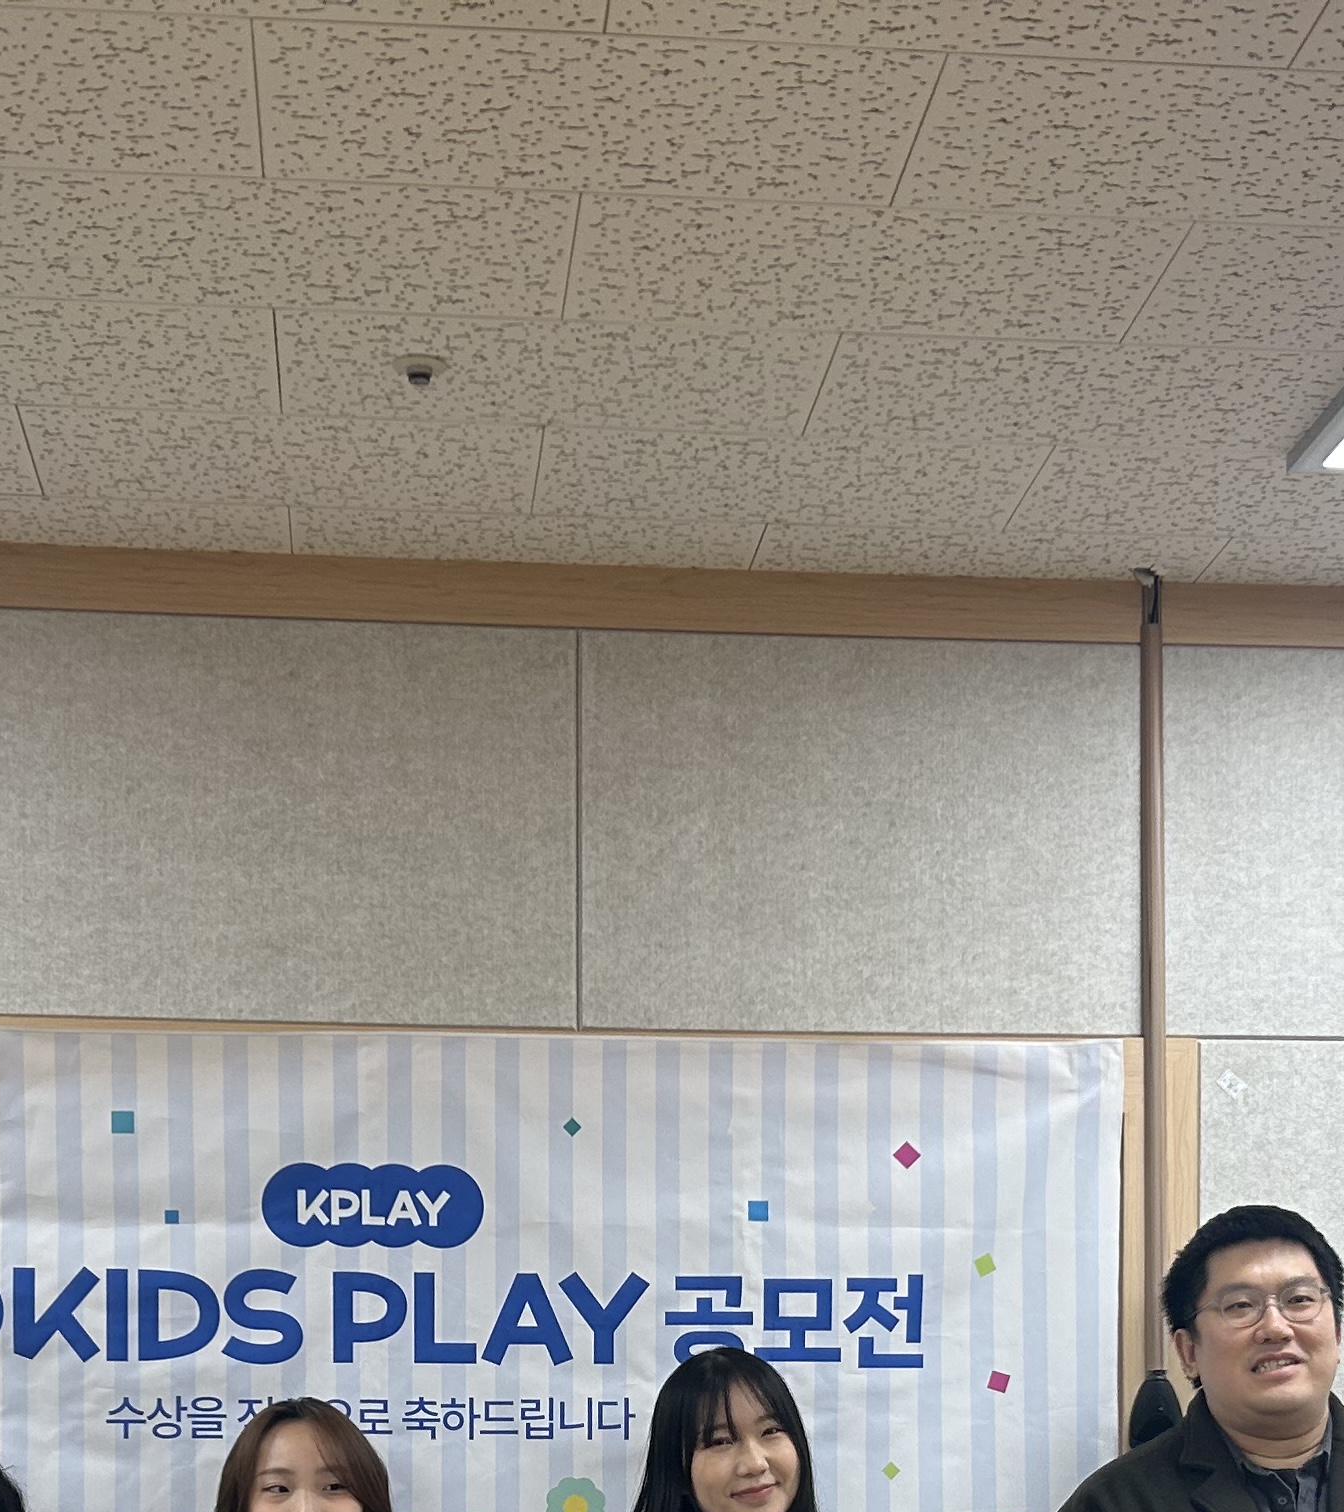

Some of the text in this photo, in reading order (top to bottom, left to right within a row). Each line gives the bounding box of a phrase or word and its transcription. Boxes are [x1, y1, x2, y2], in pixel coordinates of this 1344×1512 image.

[296, 1188, 451, 1227] KPLAY
[332, 1271, 651, 1366] PLAY
[664, 1273, 925, 1369] 공모전
[106, 1396, 227, 1440] 수상을
[401, 1396, 636, 1441] 축하드립니다
